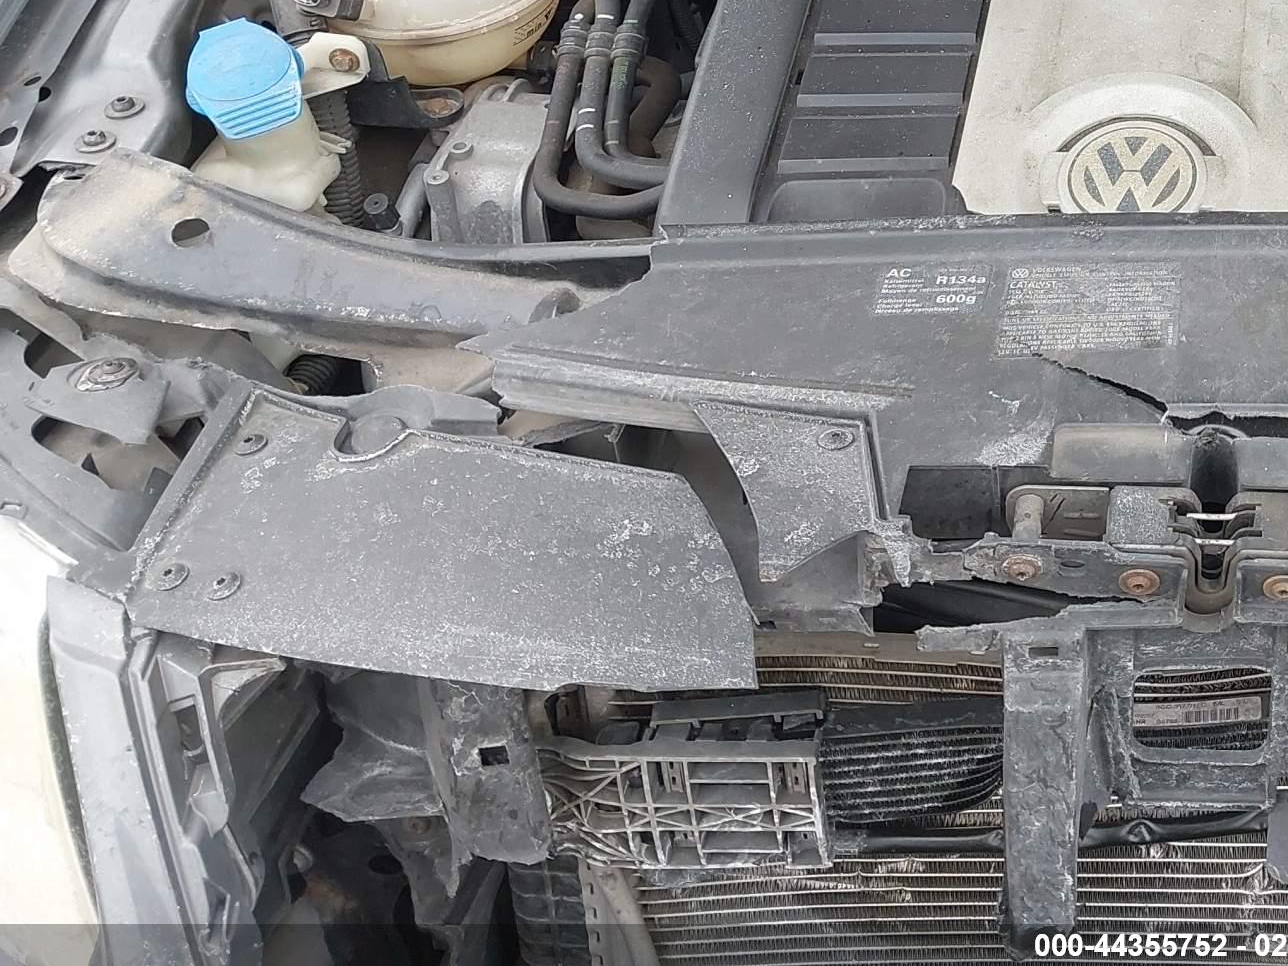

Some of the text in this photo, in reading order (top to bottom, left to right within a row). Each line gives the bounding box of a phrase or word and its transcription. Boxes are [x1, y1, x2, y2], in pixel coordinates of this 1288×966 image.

[886, 268, 912, 278] AC
[936, 276, 986, 285] R134a
[1010, 281, 1057, 289] CATALYST
[936, 294, 977, 304] 600g
